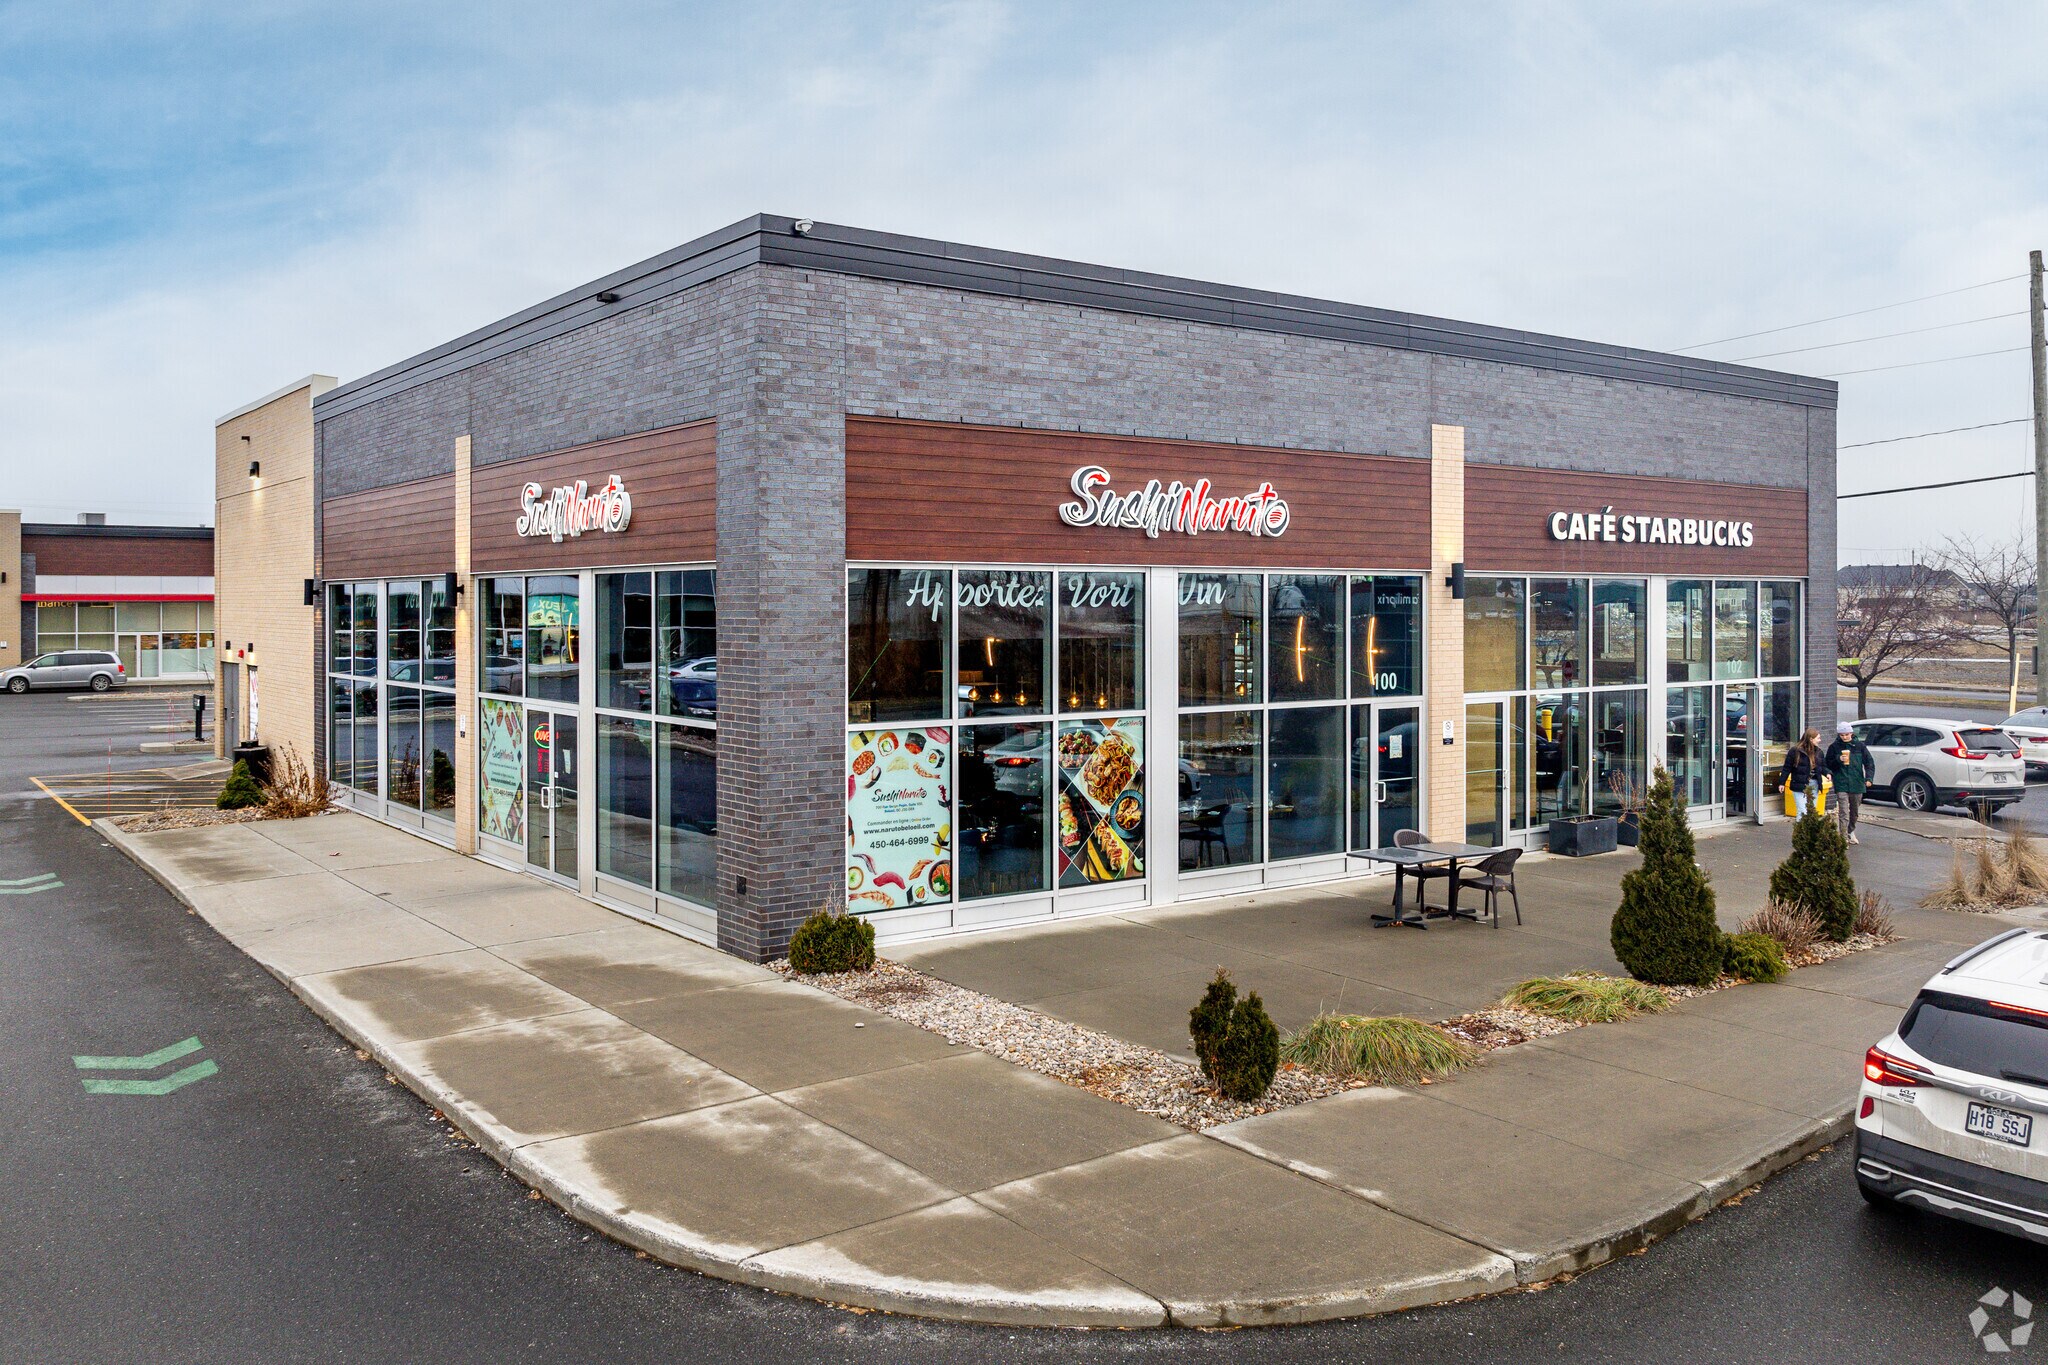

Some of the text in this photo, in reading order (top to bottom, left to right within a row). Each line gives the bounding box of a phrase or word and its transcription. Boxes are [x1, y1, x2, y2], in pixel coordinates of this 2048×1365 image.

[1550, 506, 1754, 547] CAFÉ STARBUCKS
[1727, 660, 1742, 674] 102
[1374, 672, 1397, 690] 100
[864, 823, 935, 834] www.narutobeloeil.com
[870, 836, 929, 849] 450-464-6999
[1970, 1110, 1994, 1129] H18
[2002, 1118, 2027, 1138] SSJ
